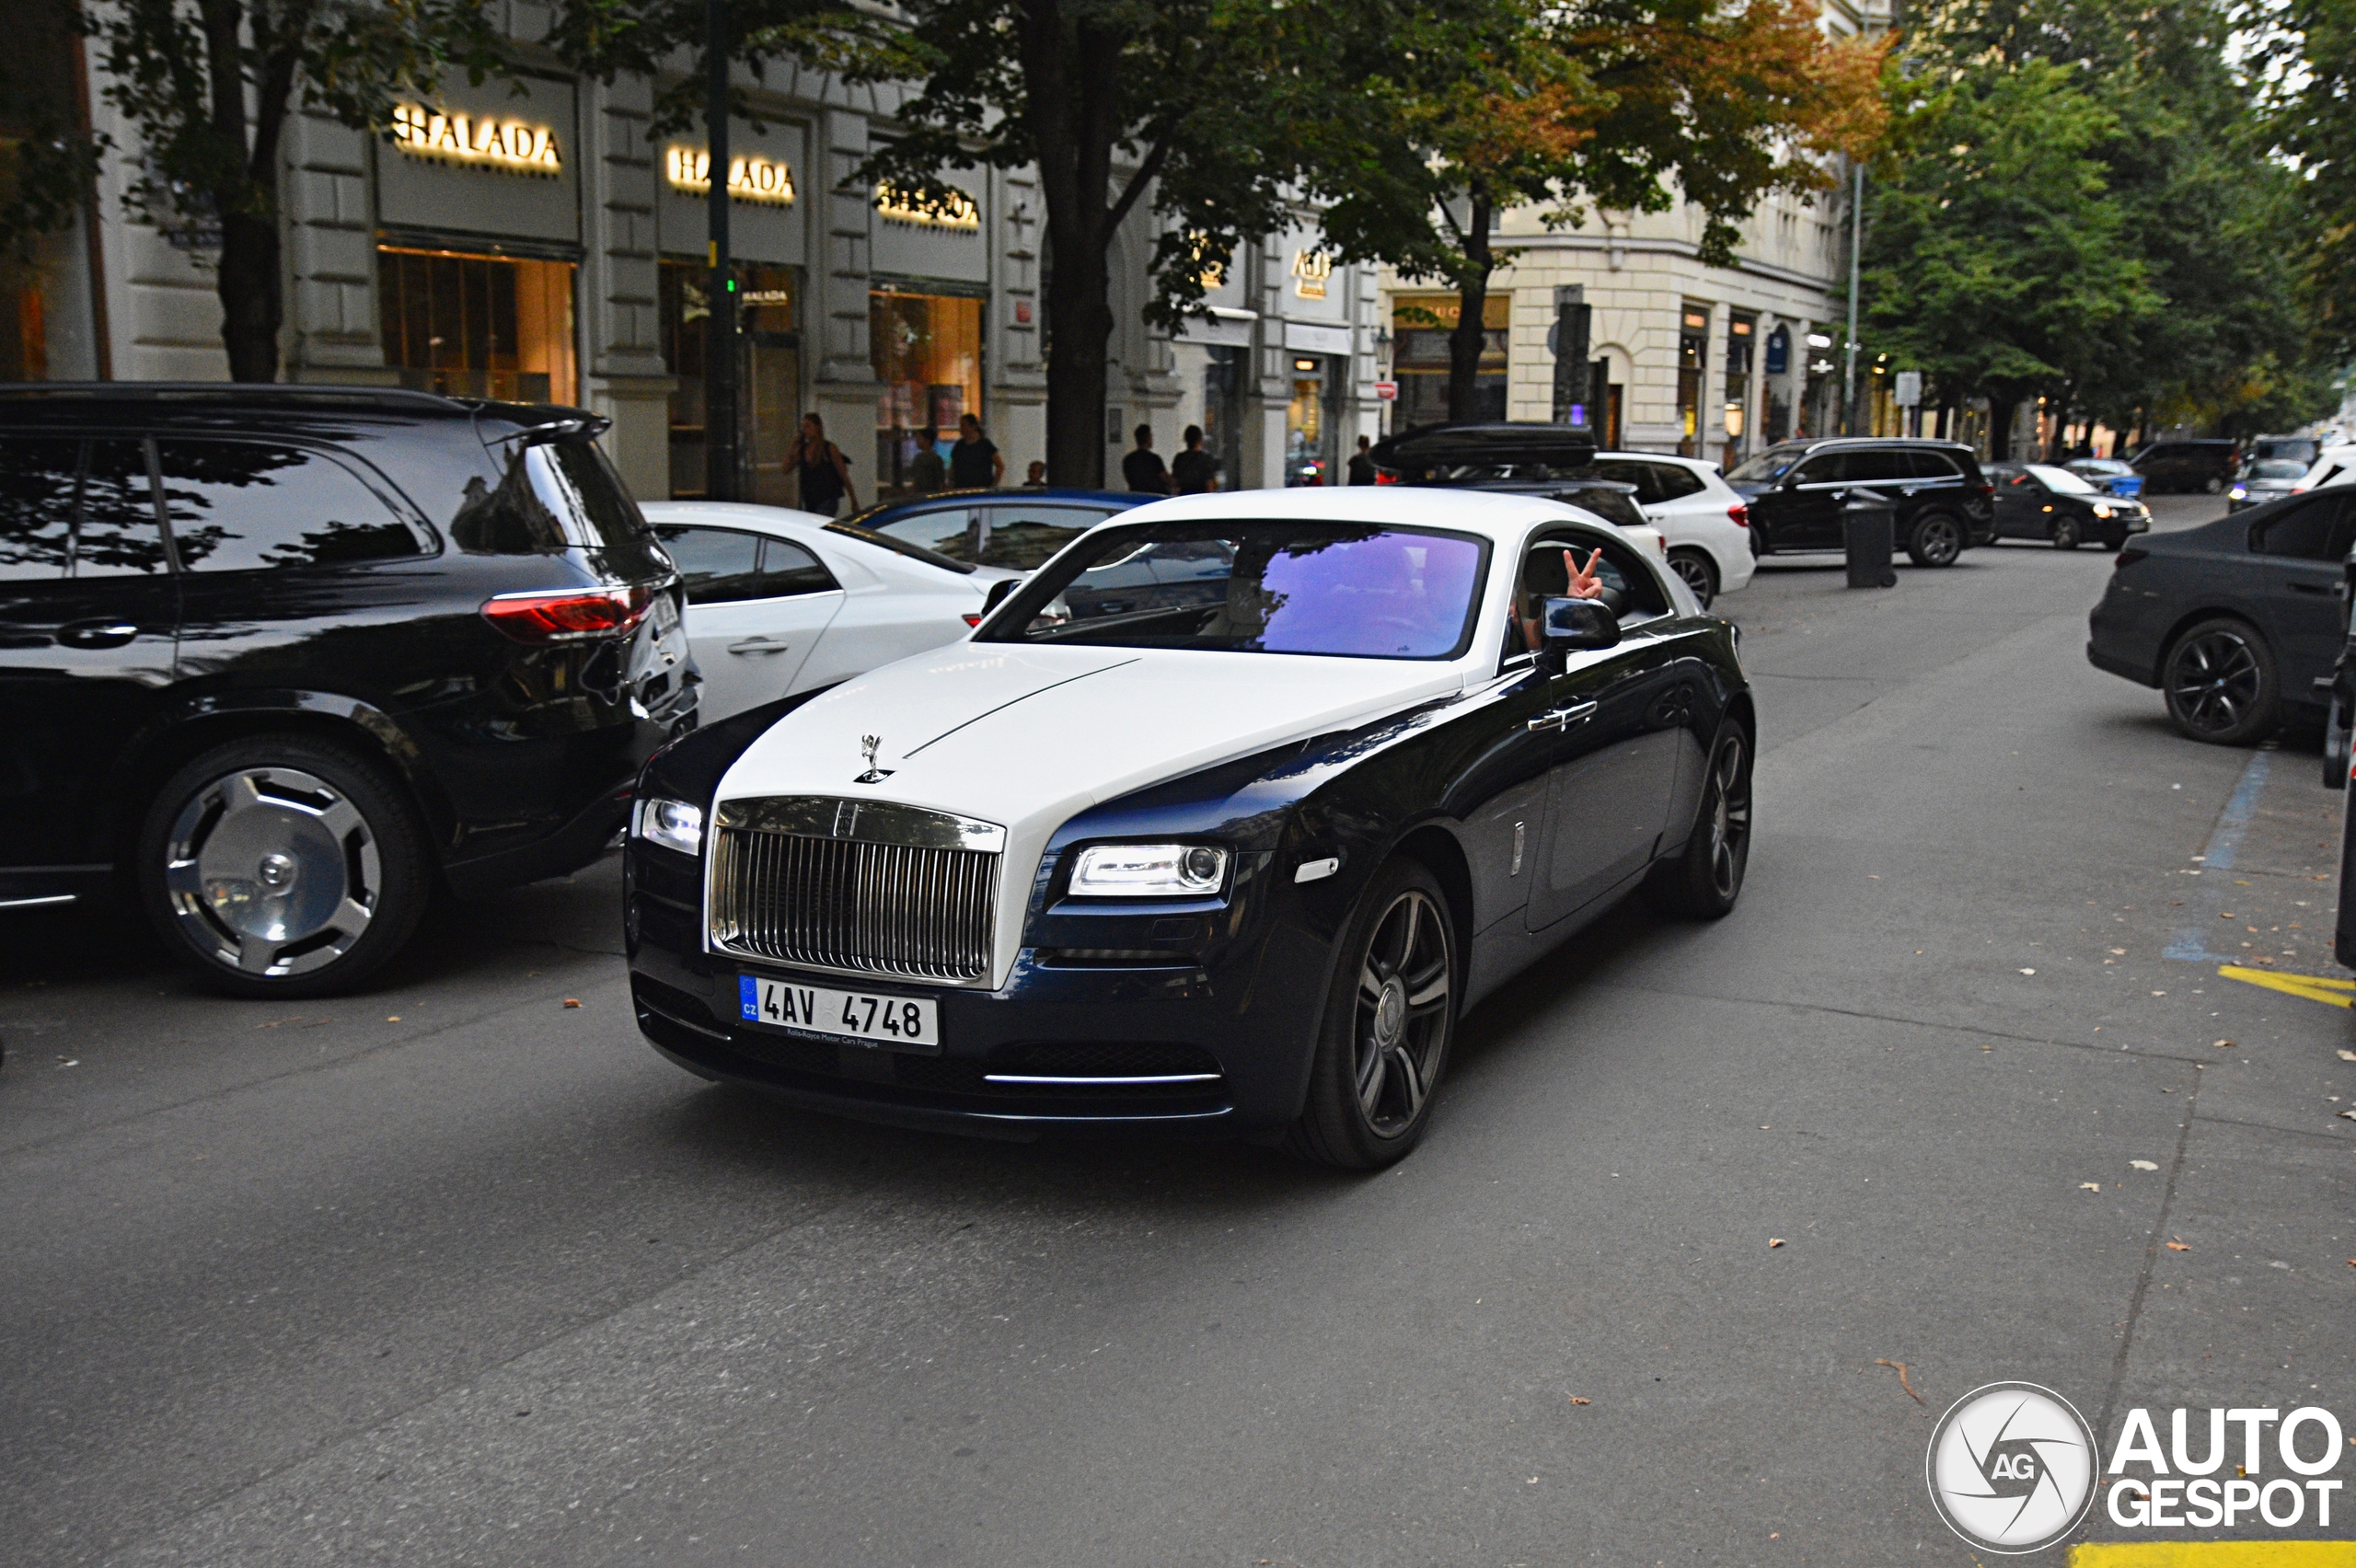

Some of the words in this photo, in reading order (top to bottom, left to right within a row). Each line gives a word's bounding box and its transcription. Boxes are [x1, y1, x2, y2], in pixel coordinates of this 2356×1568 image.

[407, 108, 561, 162] HALADA
[680, 150, 796, 194] HADA
[744, 1003, 756, 1015] CZ
[764, 984, 814, 1025] 4AV
[841, 996, 921, 1038] 4748
[787, 1028, 820, 1041] Rolls-Royce
[821, 1033, 840, 1043] Motor
[841, 1036, 856, 1045] Cars
[857, 1038, 879, 1048] Prague
